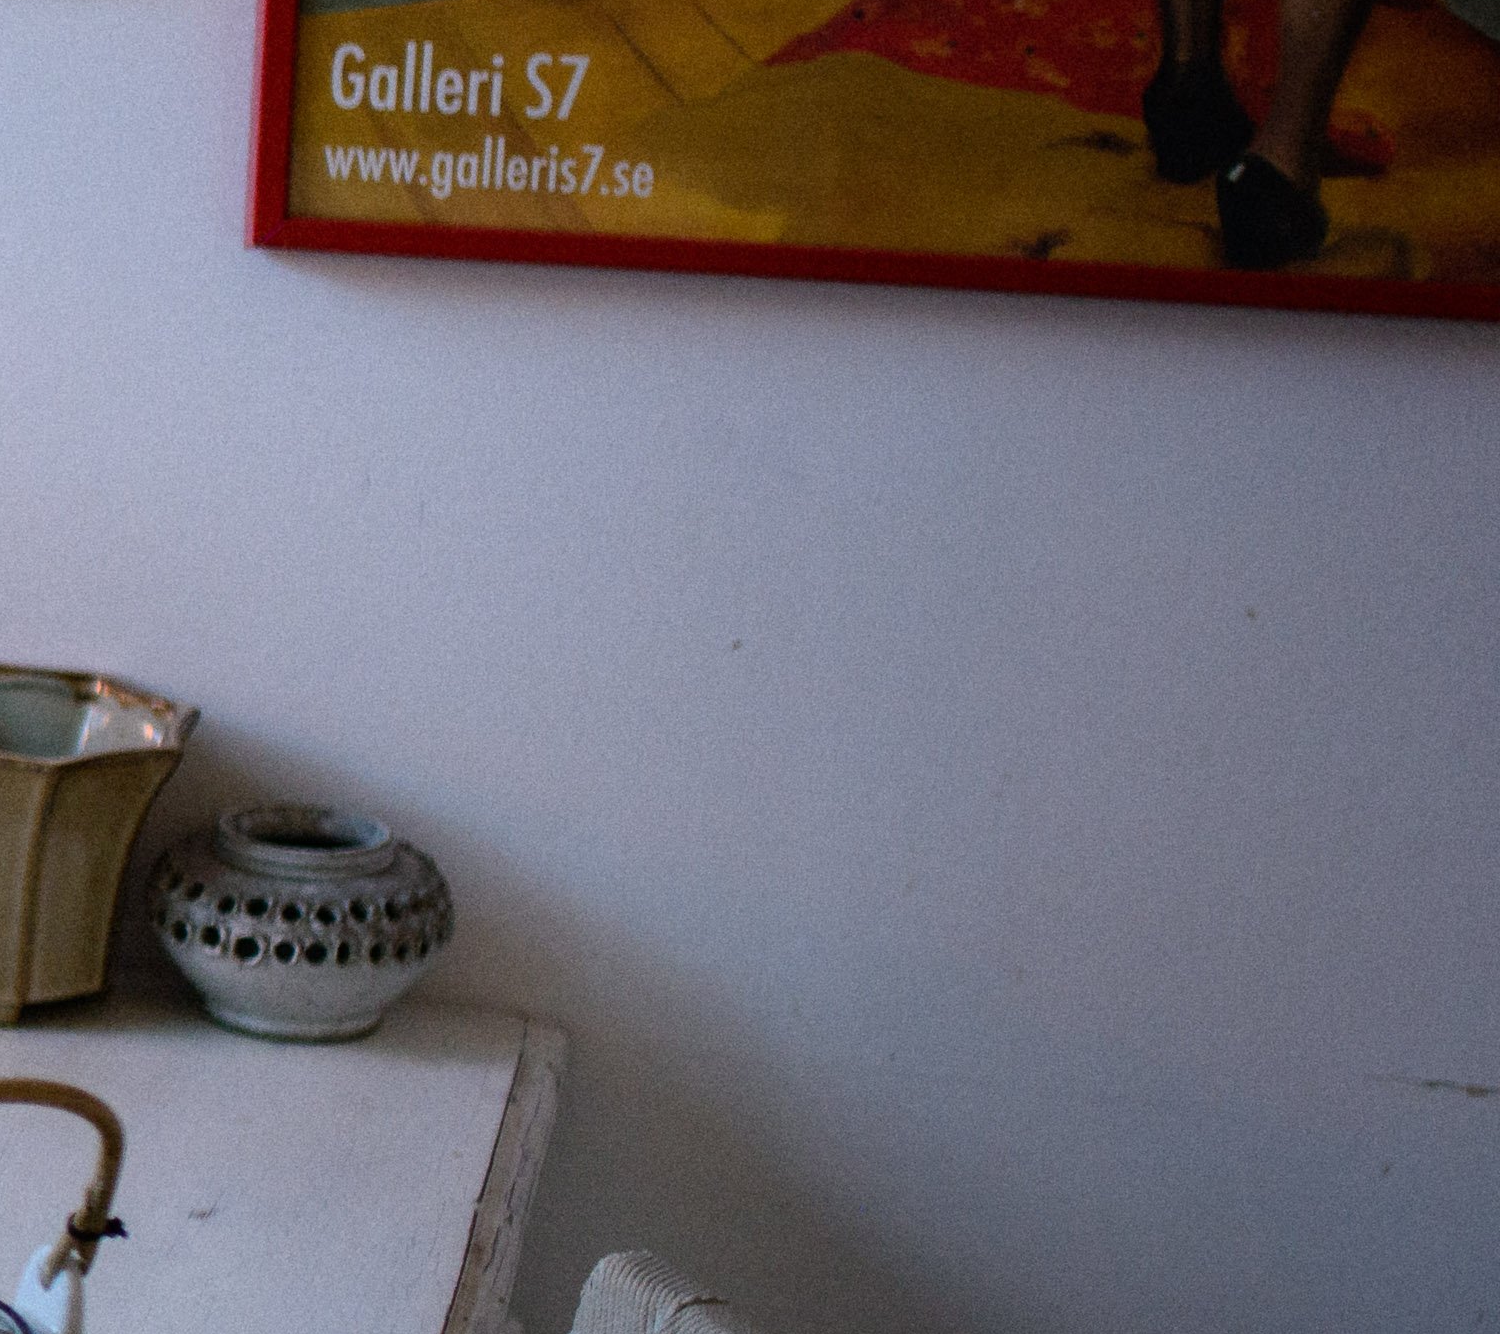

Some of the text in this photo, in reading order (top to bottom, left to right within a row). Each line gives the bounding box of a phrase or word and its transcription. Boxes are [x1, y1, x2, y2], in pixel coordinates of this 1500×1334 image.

[330, 39, 591, 122] Galleri S7
[323, 133, 656, 201] www.galleris7.se
